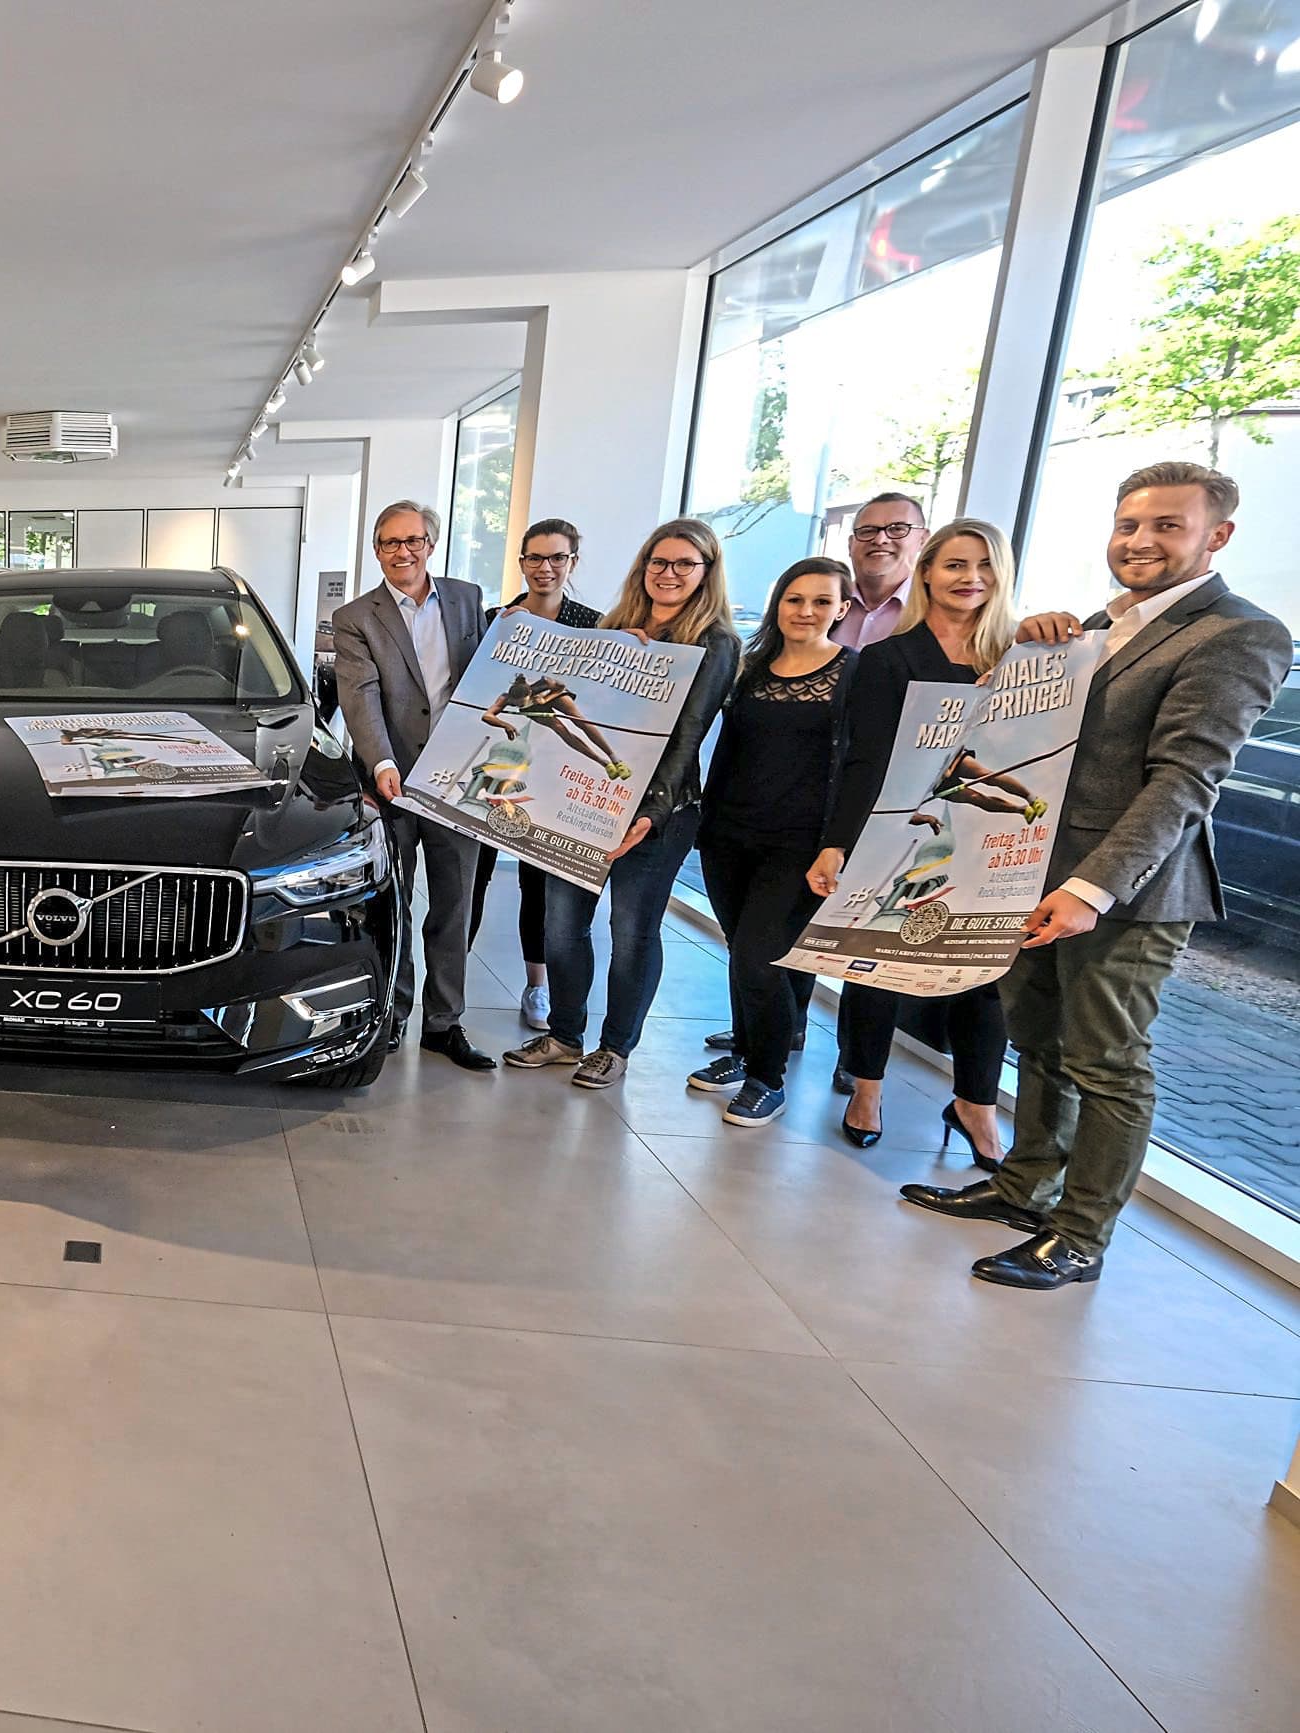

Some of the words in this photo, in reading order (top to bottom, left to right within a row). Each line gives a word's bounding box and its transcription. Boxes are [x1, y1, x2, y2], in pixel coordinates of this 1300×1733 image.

[511, 623, 534, 647] 38.
[535, 631, 673, 678] INTERNATIONALES
[491, 641, 675, 703] MARKTPLATZSPRINGEN
[936, 697, 965, 723] 38.
[915, 723, 963, 748] MAR
[566, 787, 578, 799] ab
[581, 791, 606, 809] 15.30
[598, 779, 611, 794] 31.
[612, 784, 633, 801] Mai
[534, 829, 548, 842] DIE
[550, 835, 576, 851] GUTE
[577, 846, 607, 864] STUBE
[988, 856, 1001, 869] ab
[1002, 849, 1027, 867] 15.30
[36, 914, 77, 922] VOLVO
[950, 917, 968, 930] DIE
[967, 917, 995, 930] GUTE
[995, 916, 1028, 929] STUBE
